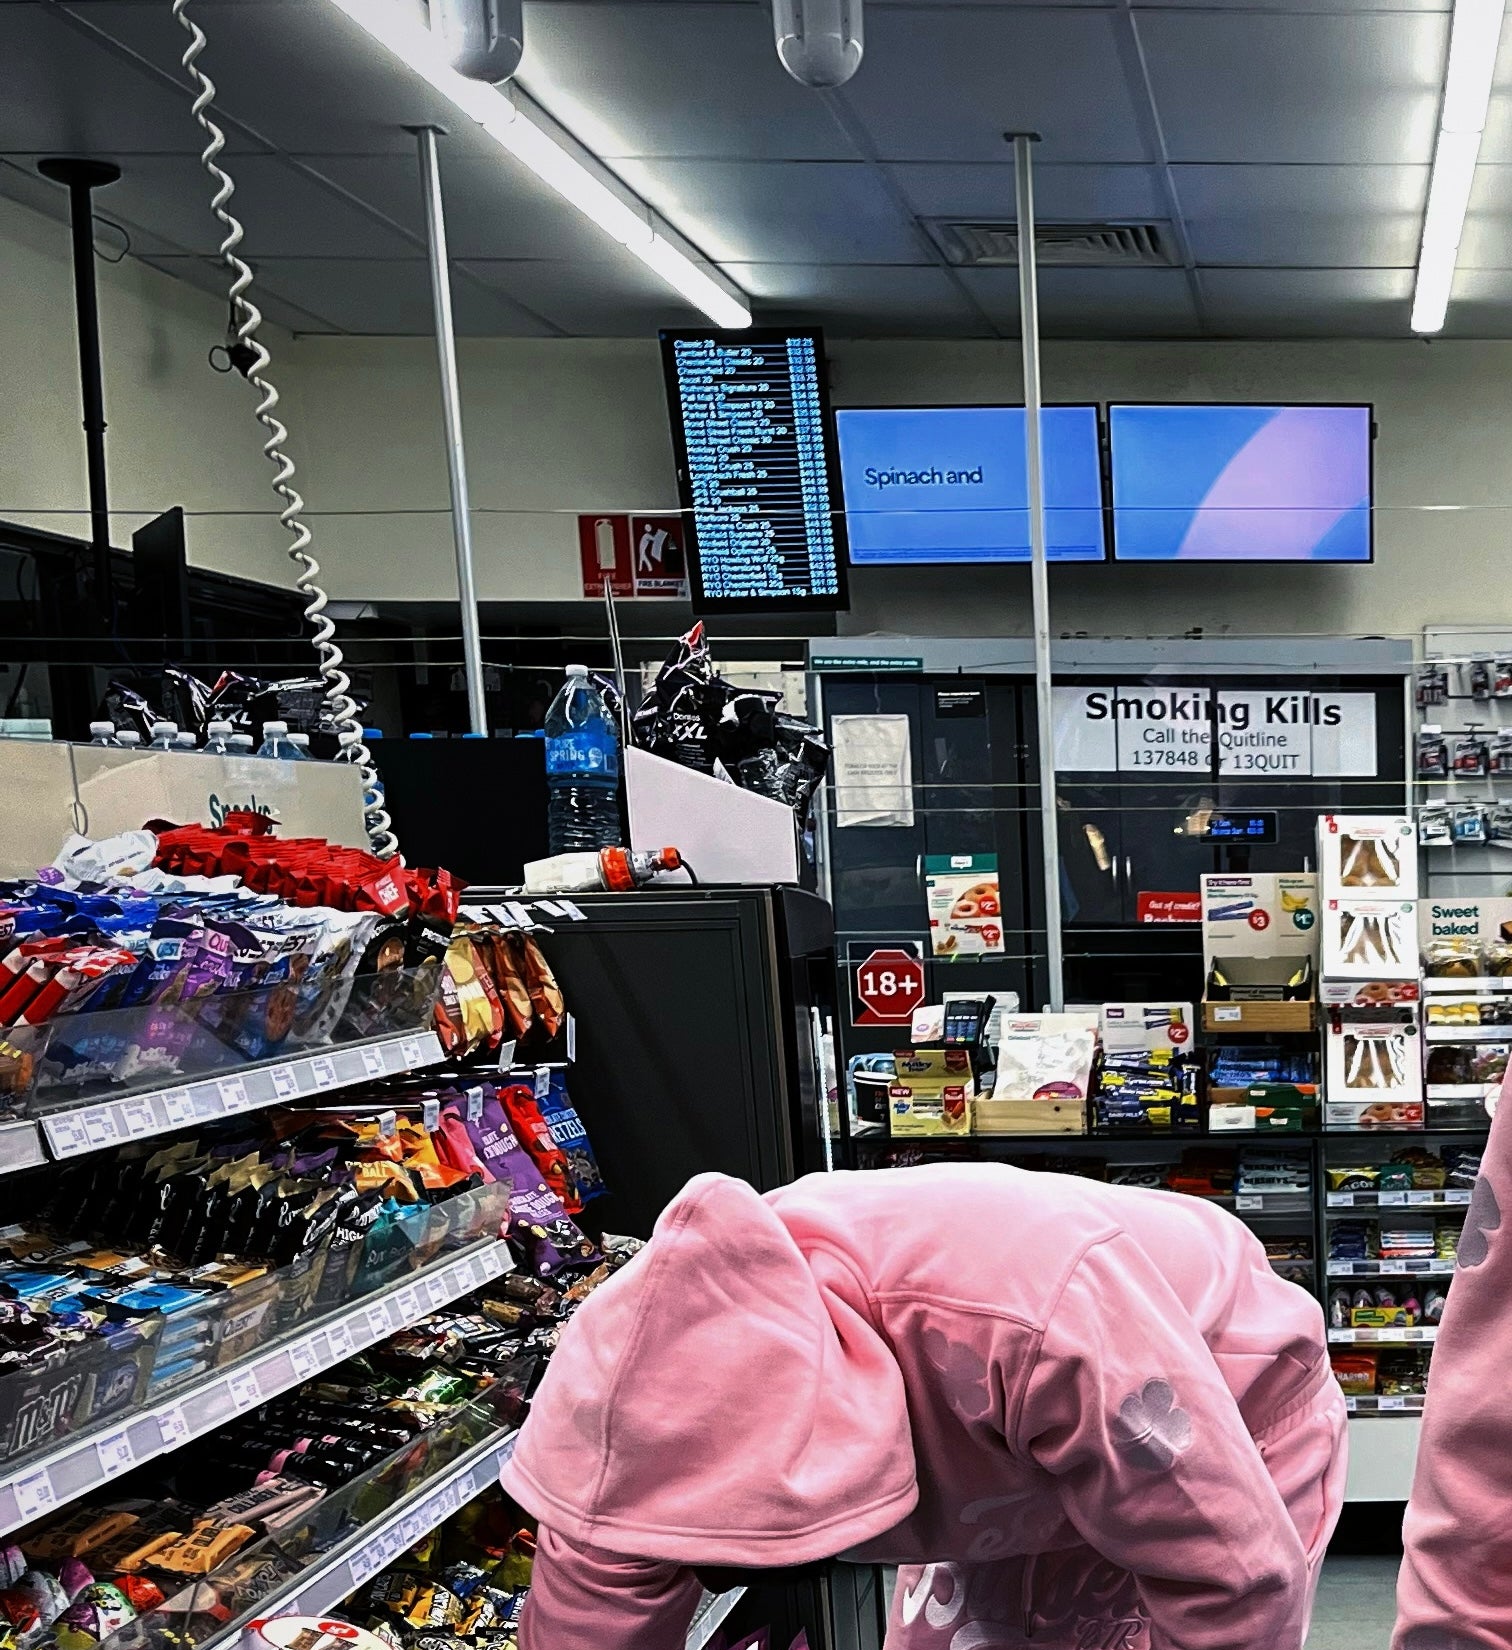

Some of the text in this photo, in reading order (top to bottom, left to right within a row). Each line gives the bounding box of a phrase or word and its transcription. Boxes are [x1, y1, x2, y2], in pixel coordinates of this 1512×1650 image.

[864, 463, 983, 489] Spinach and
[210, 710, 253, 725] XXL
[1085, 692, 1342, 731] Smoking Kills
[672, 722, 708, 740] XXL
[554, 738, 575, 750] PURE
[1143, 728, 1288, 751] Call the Quitline
[549, 749, 586, 762] SPRING
[1132, 750, 1198, 767] 137848
[1233, 753, 1300, 773] 13QUIT
[1431, 905, 1479, 920] Sweet
[1432, 921, 1479, 936] baked
[864, 968, 919, 997] 18+
[890, 1087, 911, 1096] NEW
[362, 1165, 388, 1178] BALL
